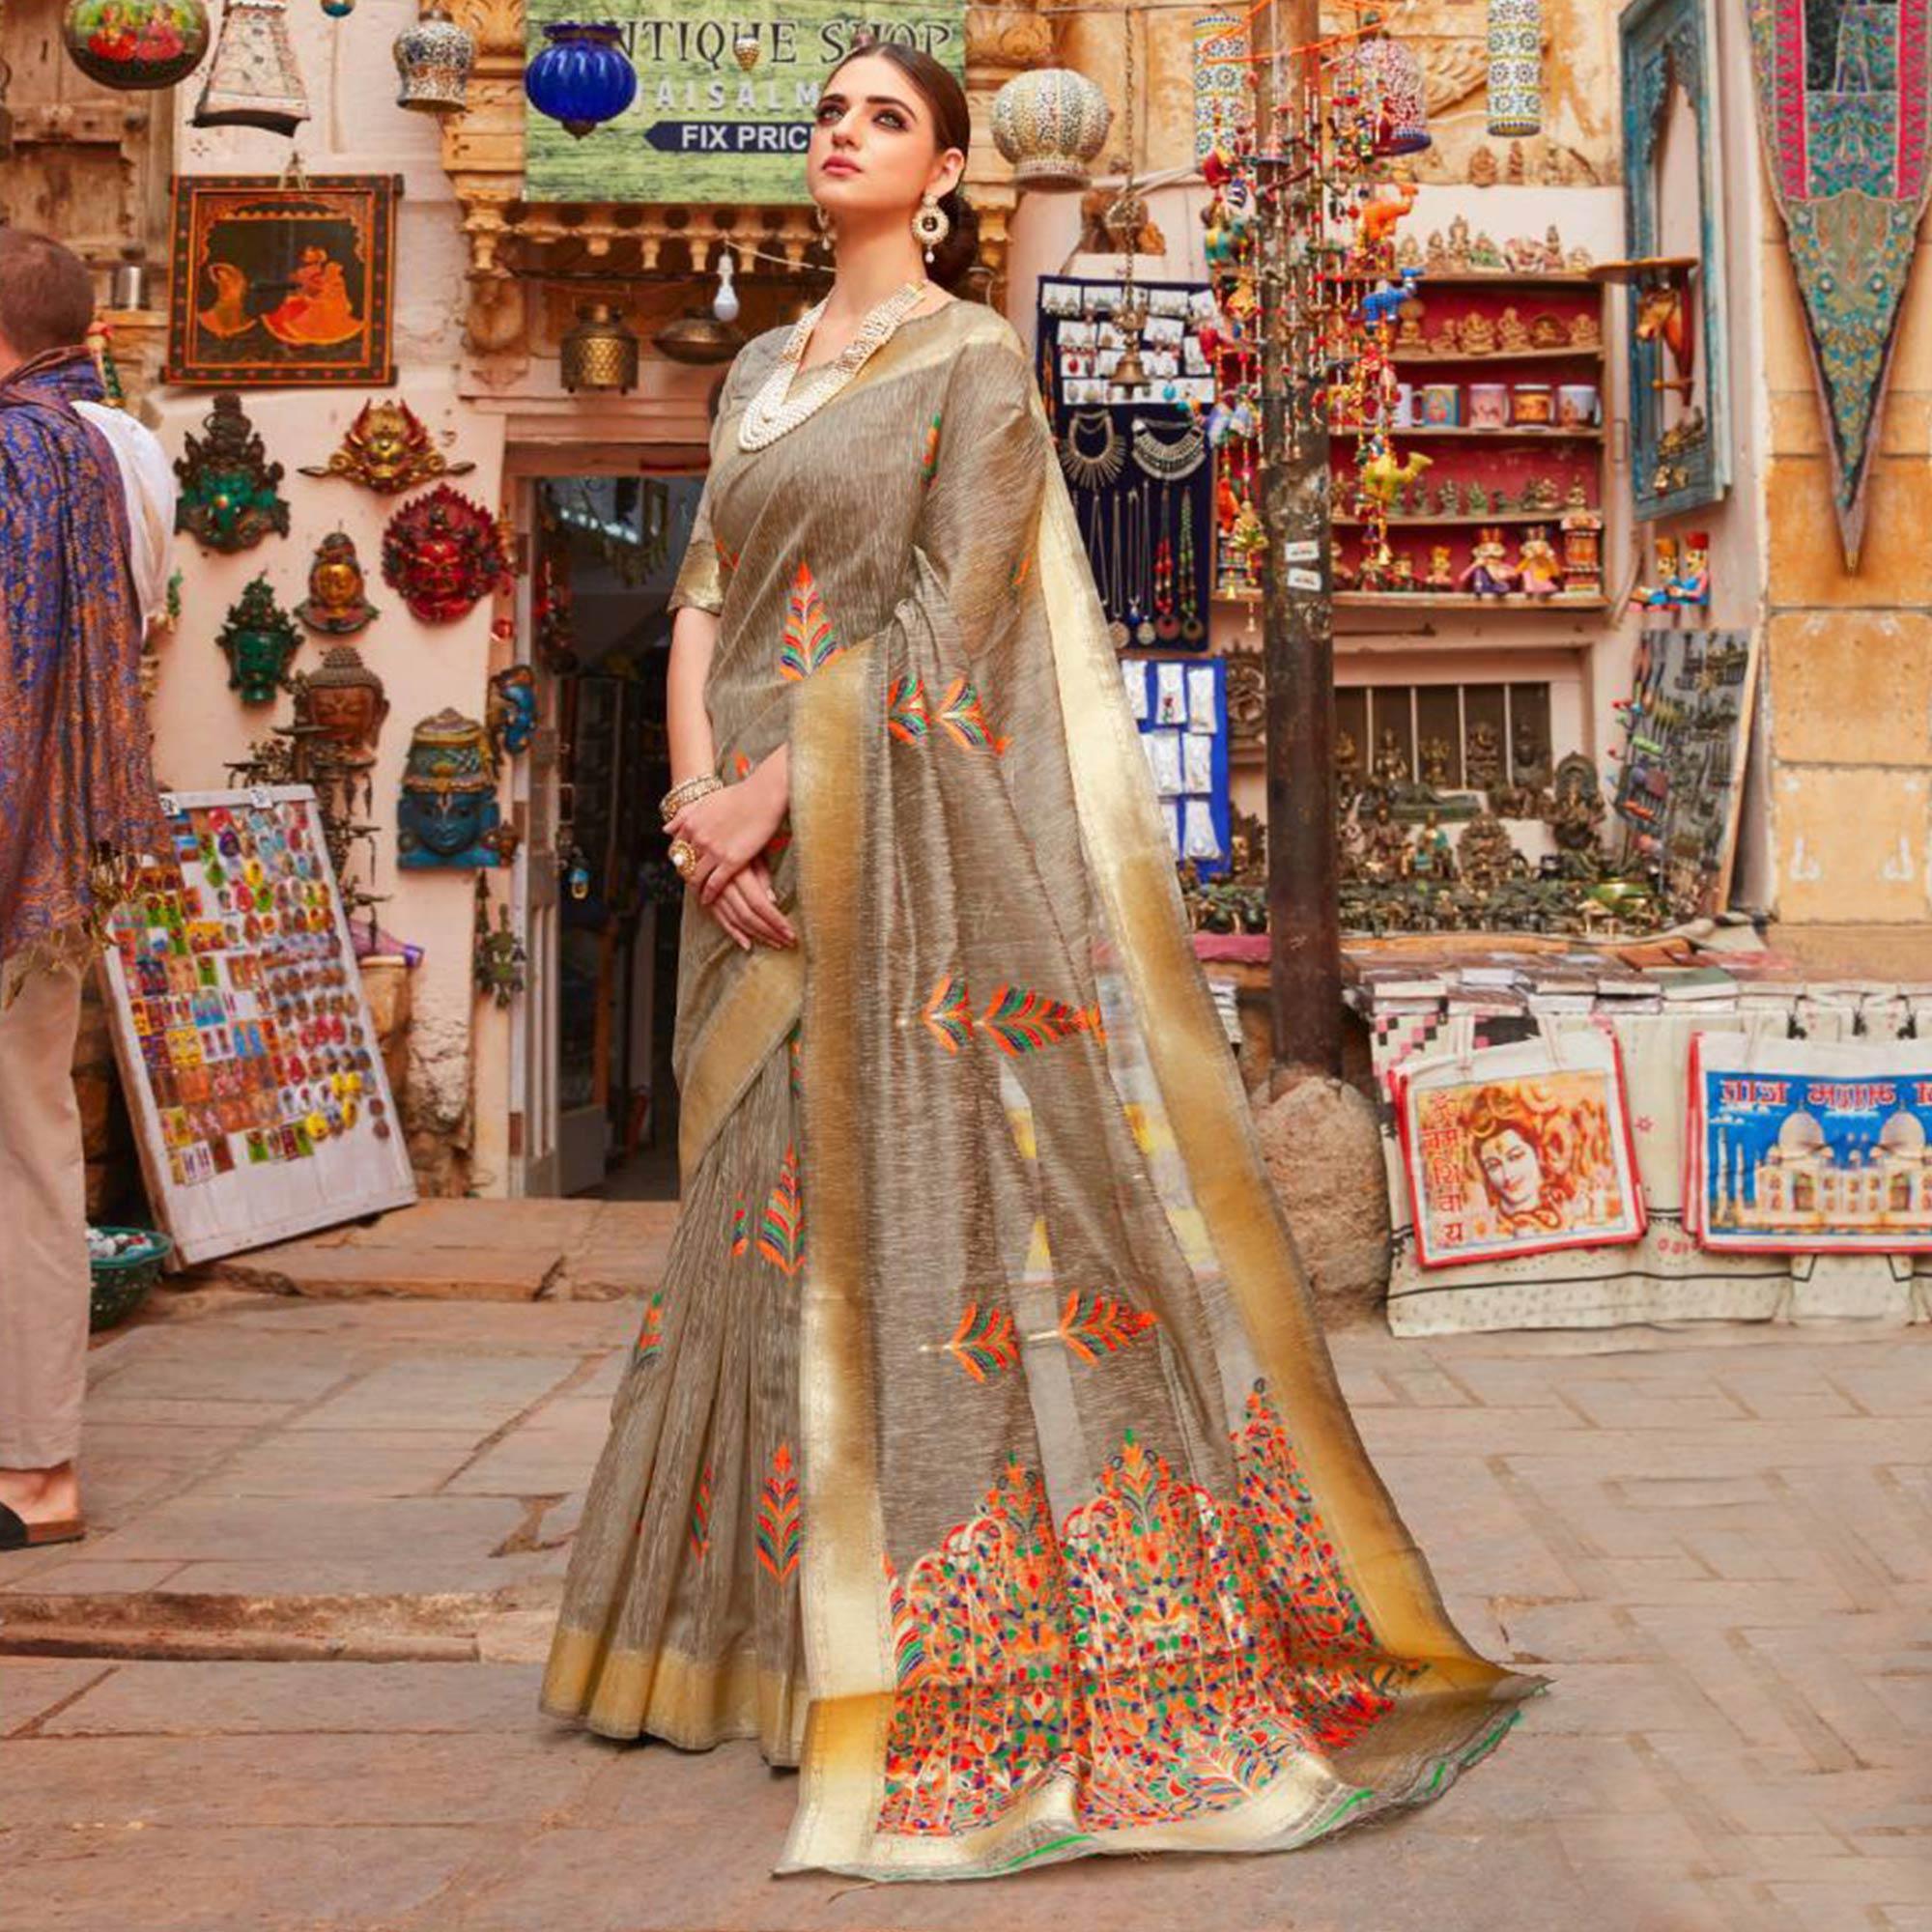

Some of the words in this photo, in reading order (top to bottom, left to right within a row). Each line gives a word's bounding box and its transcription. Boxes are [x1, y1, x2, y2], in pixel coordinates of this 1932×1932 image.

[636, 79, 820, 112] JAISALM
[682, 125, 728, 150] FIX
[738, 125, 813, 150] PRIC
